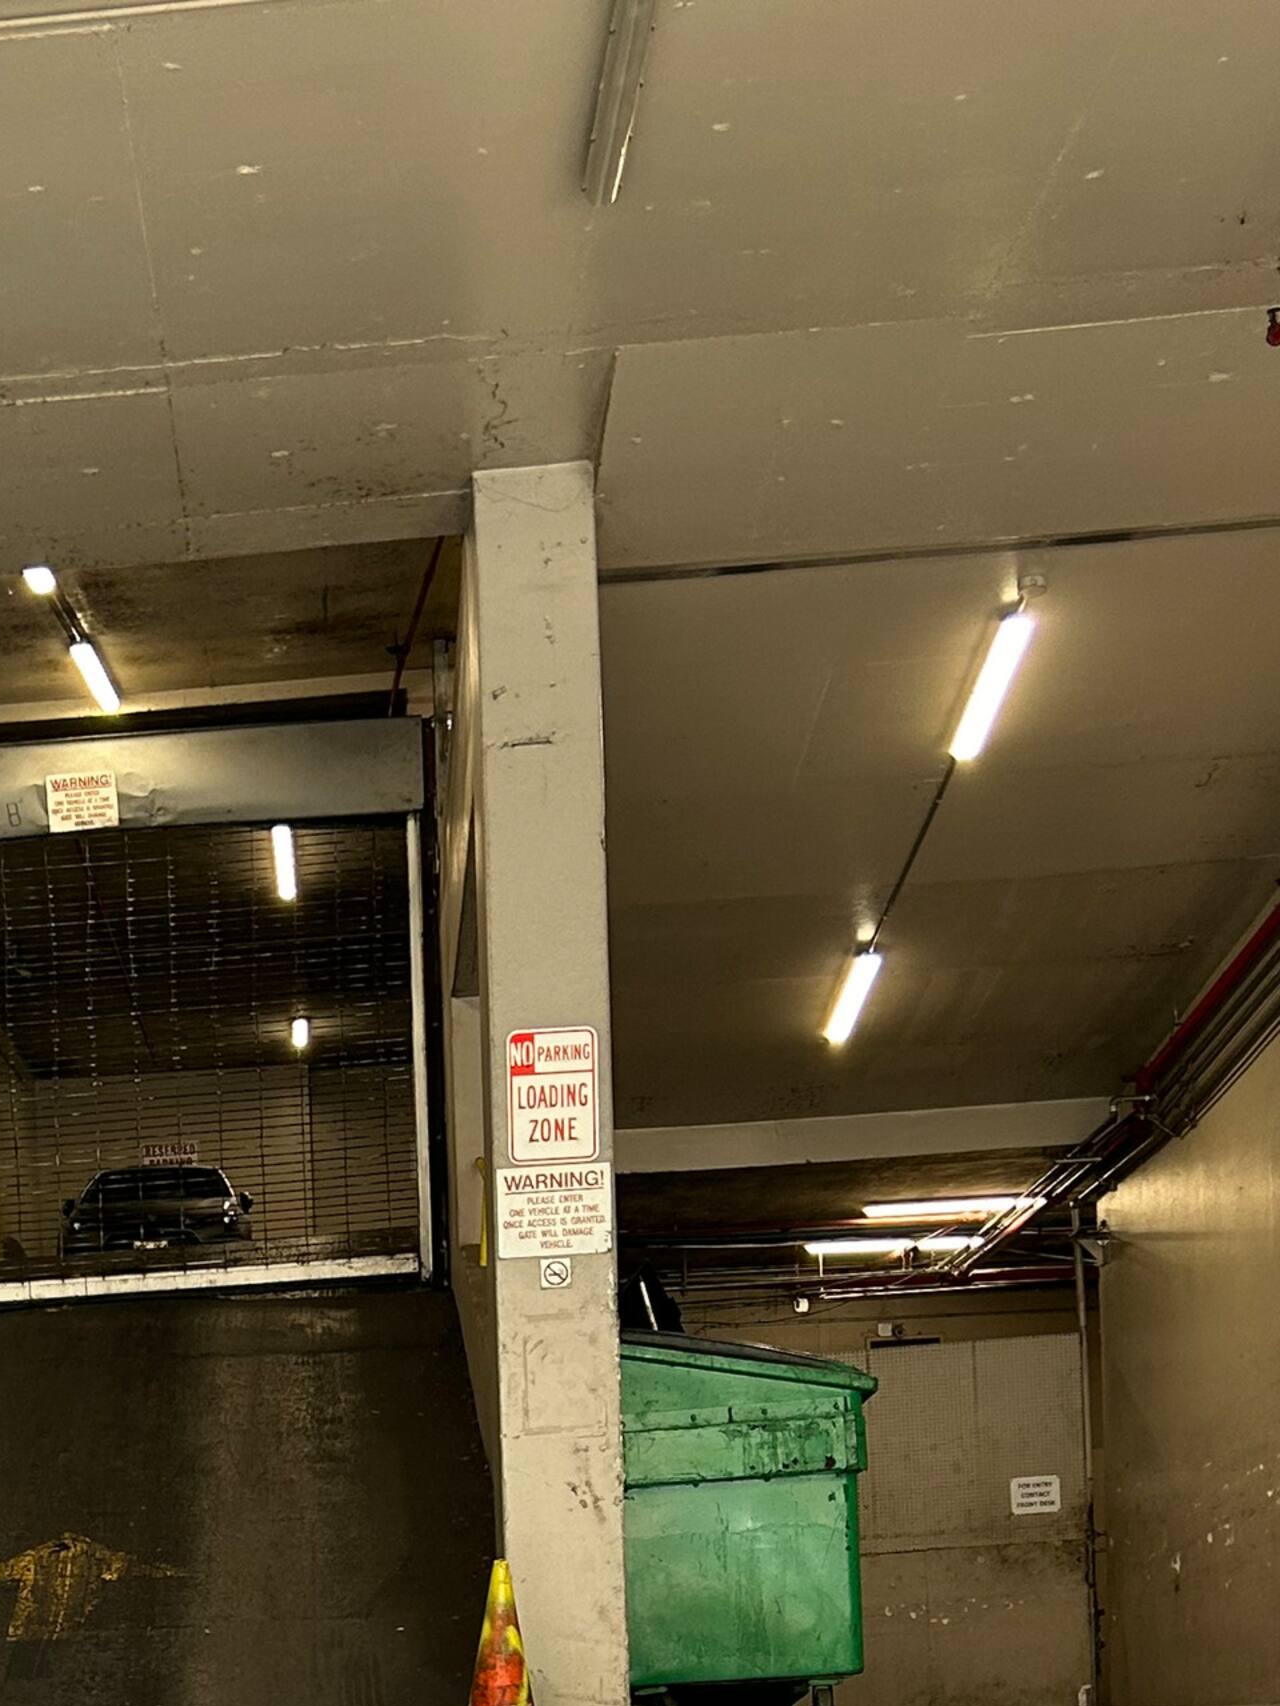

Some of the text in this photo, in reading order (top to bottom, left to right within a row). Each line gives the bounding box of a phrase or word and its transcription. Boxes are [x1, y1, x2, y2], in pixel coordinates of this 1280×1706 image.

[50, 774, 112, 791] WARNING!
[510, 1042, 591, 1067] NO PARKING
[517, 1083, 589, 1109] LOADING
[528, 1117, 578, 1143] ZONE
[504, 1170, 605, 1193] WARNING!
[526, 1193, 584, 1205] PLEASE ENTER
[509, 1203, 600, 1217] ONE VEHICLE AT A TIME
[503, 1219, 525, 1230] ONCE
[527, 1217, 558, 1228] ACCESS
[559, 1217, 569, 1226] IS
[518, 1227, 595, 1240] GATE WILL DAMAGE
